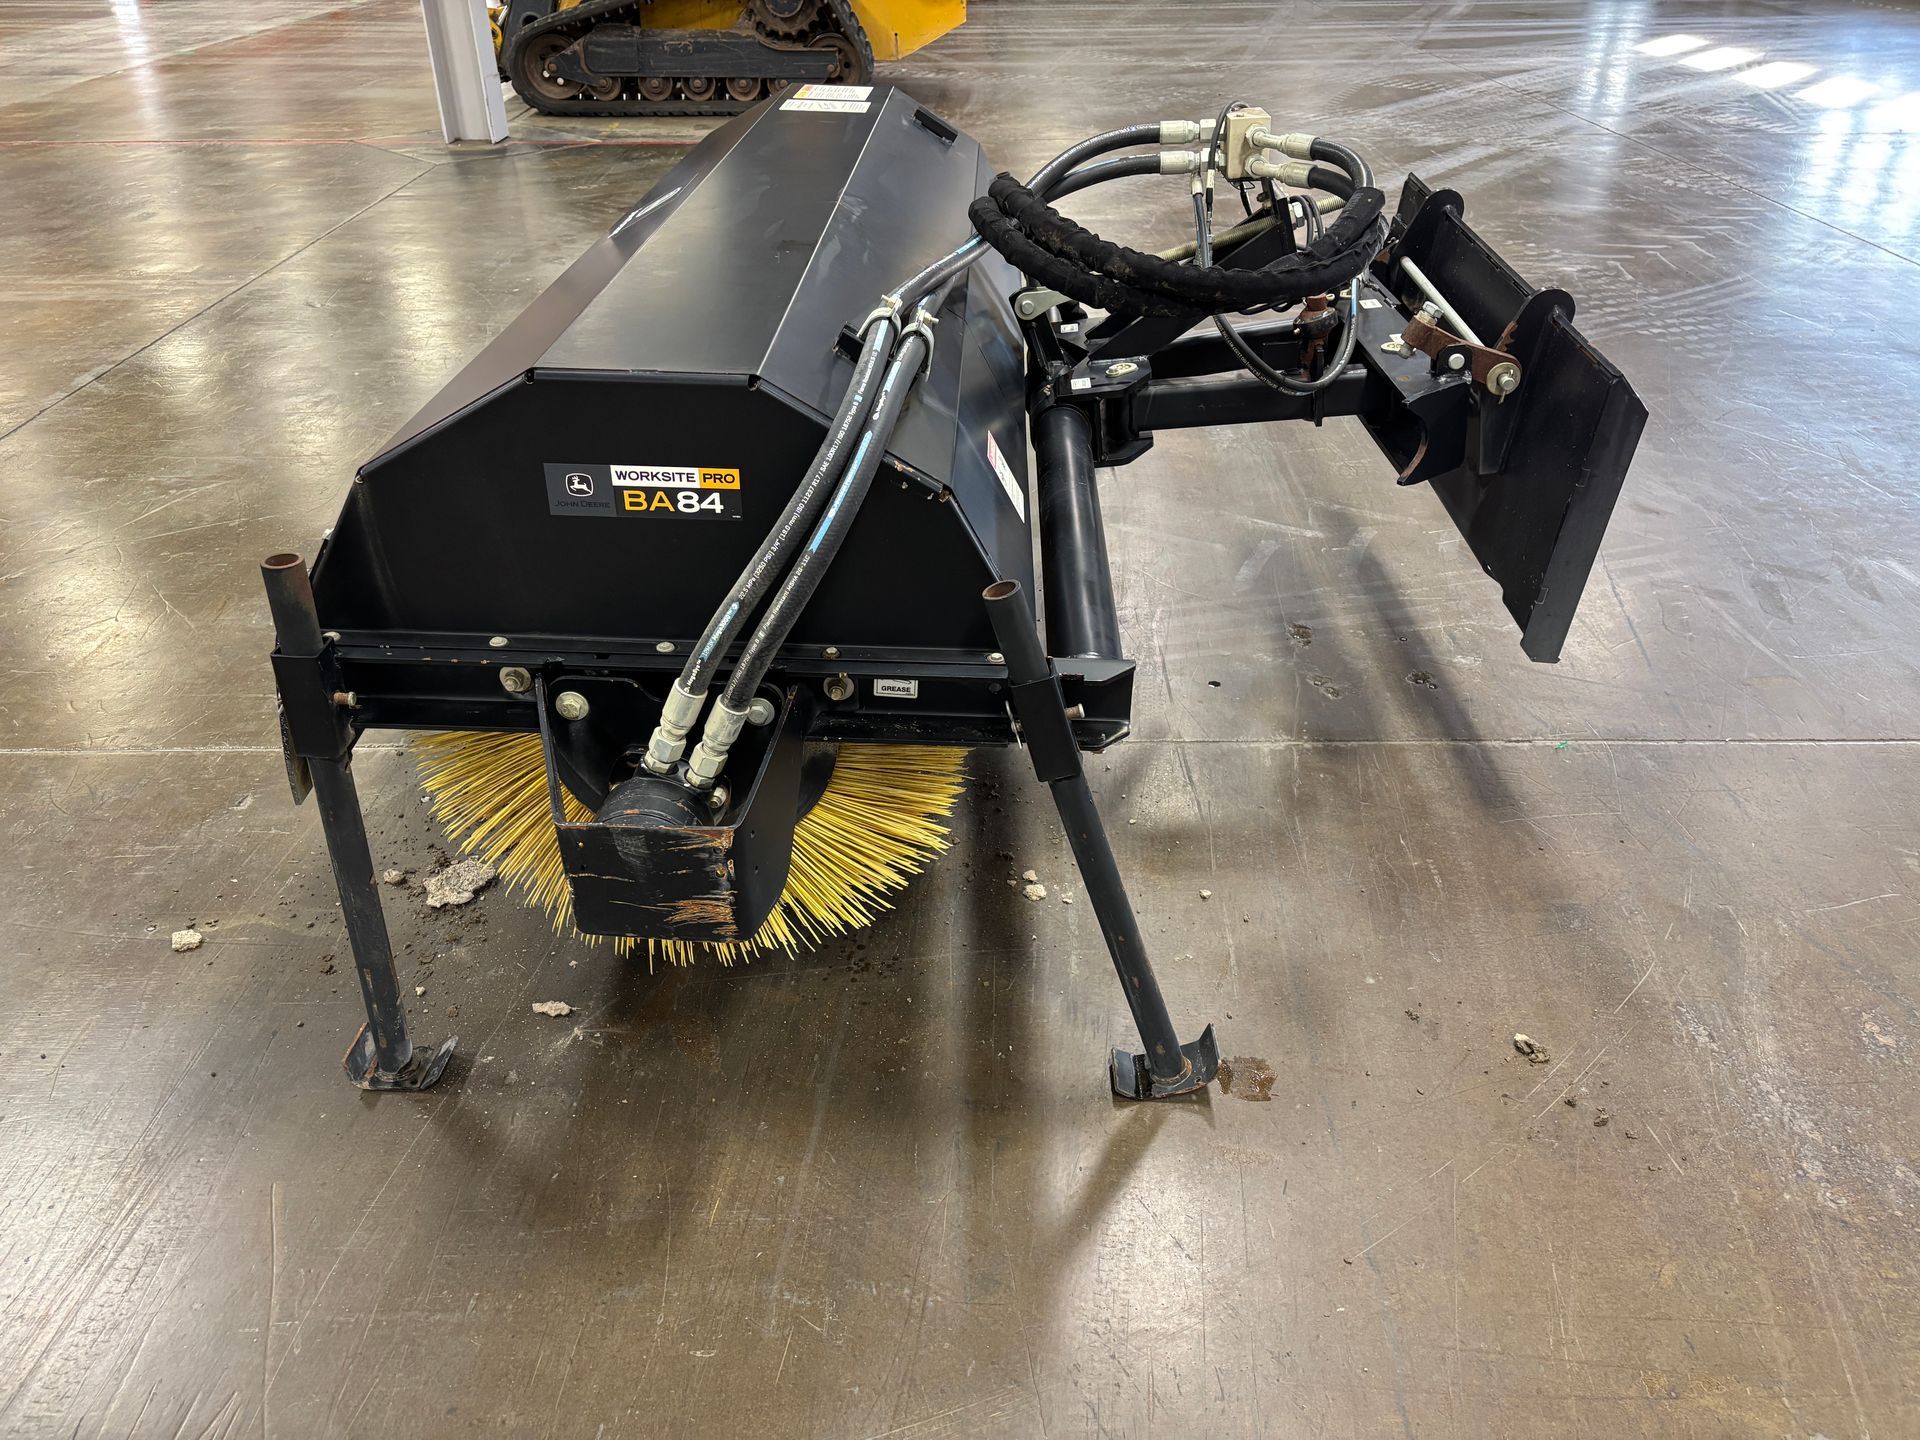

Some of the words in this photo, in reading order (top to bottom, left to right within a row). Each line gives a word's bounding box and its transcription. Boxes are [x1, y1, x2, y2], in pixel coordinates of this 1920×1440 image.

[615, 470, 696, 482] WORKSITE
[702, 474, 736, 484] PRO
[580, 501, 611, 509] DEERE
[623, 490, 724, 514] BA84
[746, 577, 756, 588] MPa
[753, 562, 766, 578] (3250
[788, 512, 800, 526] mm)
[802, 486, 814, 504] 11237
[820, 461, 830, 472] SAE
